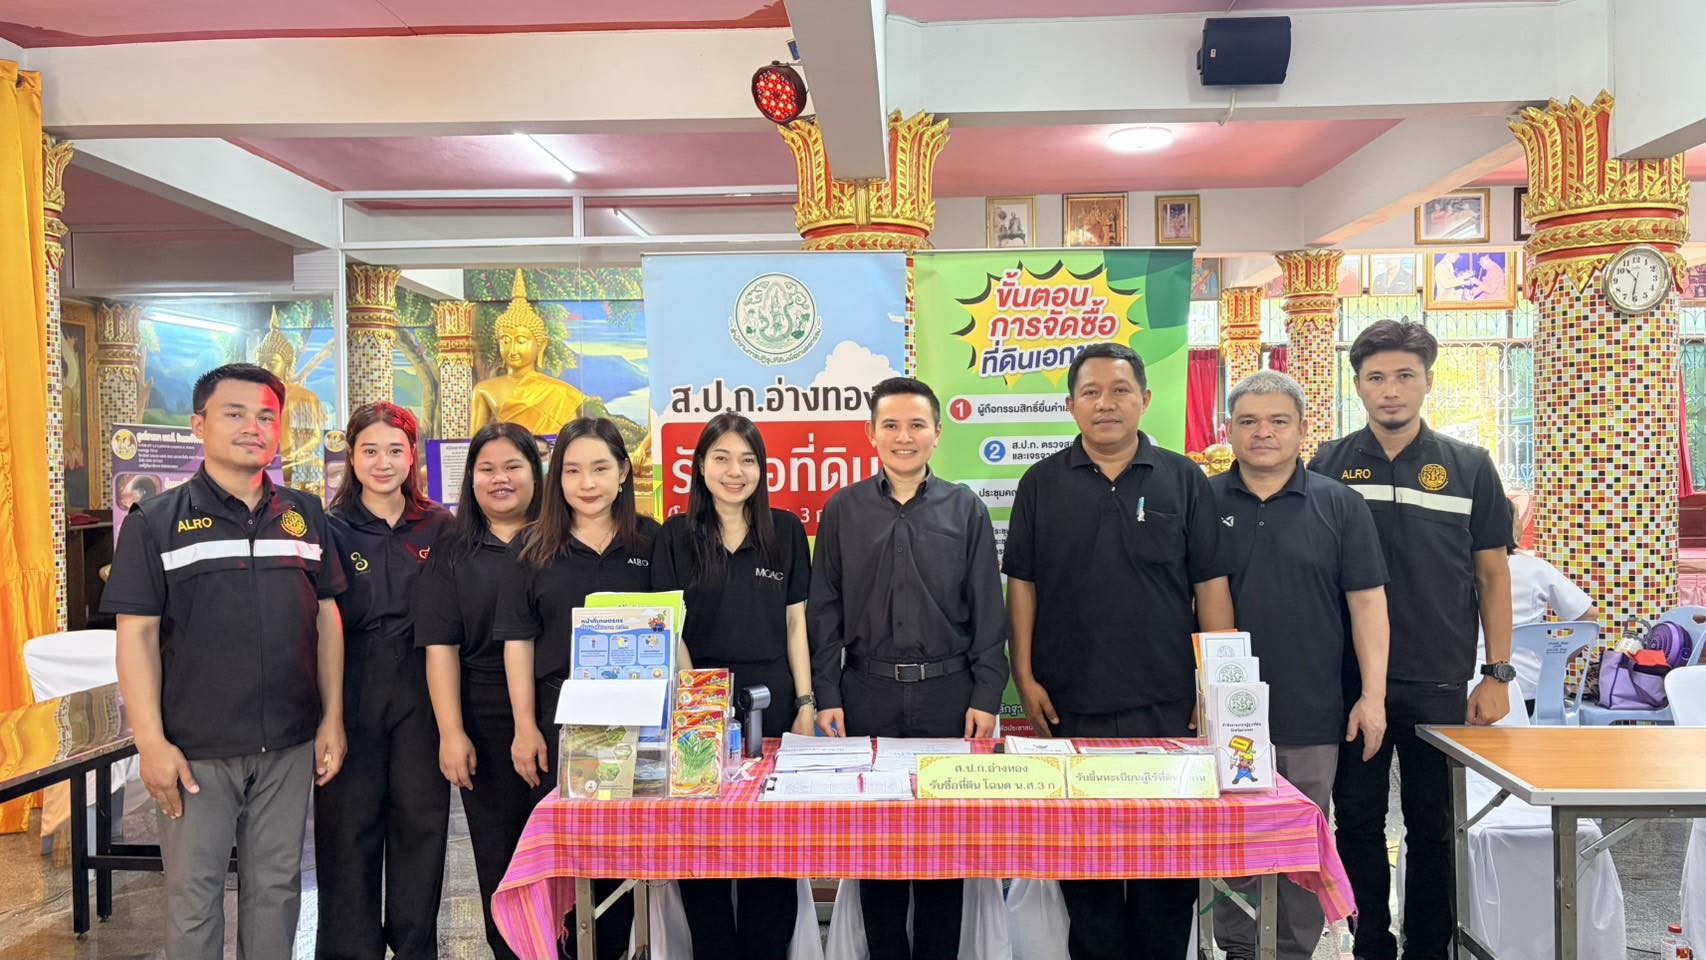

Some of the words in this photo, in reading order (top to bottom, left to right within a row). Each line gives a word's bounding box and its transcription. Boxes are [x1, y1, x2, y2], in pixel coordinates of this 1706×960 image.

[997, 272, 1090, 307] ขั้นตอน
[990, 300, 1117, 337] การจัดซื้อ
[981, 340, 1086, 375] ที่ดินเอก
[955, 402, 964, 418] 1
[989, 444, 1001, 459] 2
[1012, 440, 1039, 450] ส.ป.ก.
[1341, 468, 1372, 480] ALRO
[178, 517, 212, 533] ALRO
[627, 558, 649, 567] ALRO
[954, 763, 1028, 773] ส.ป.ก.อ่างทอง
[930, 777, 981, 790] รับซื้อที่ดิน
[982, 778, 1011, 790] โฉนด
[1015, 781, 1045, 790] น.ส.3
